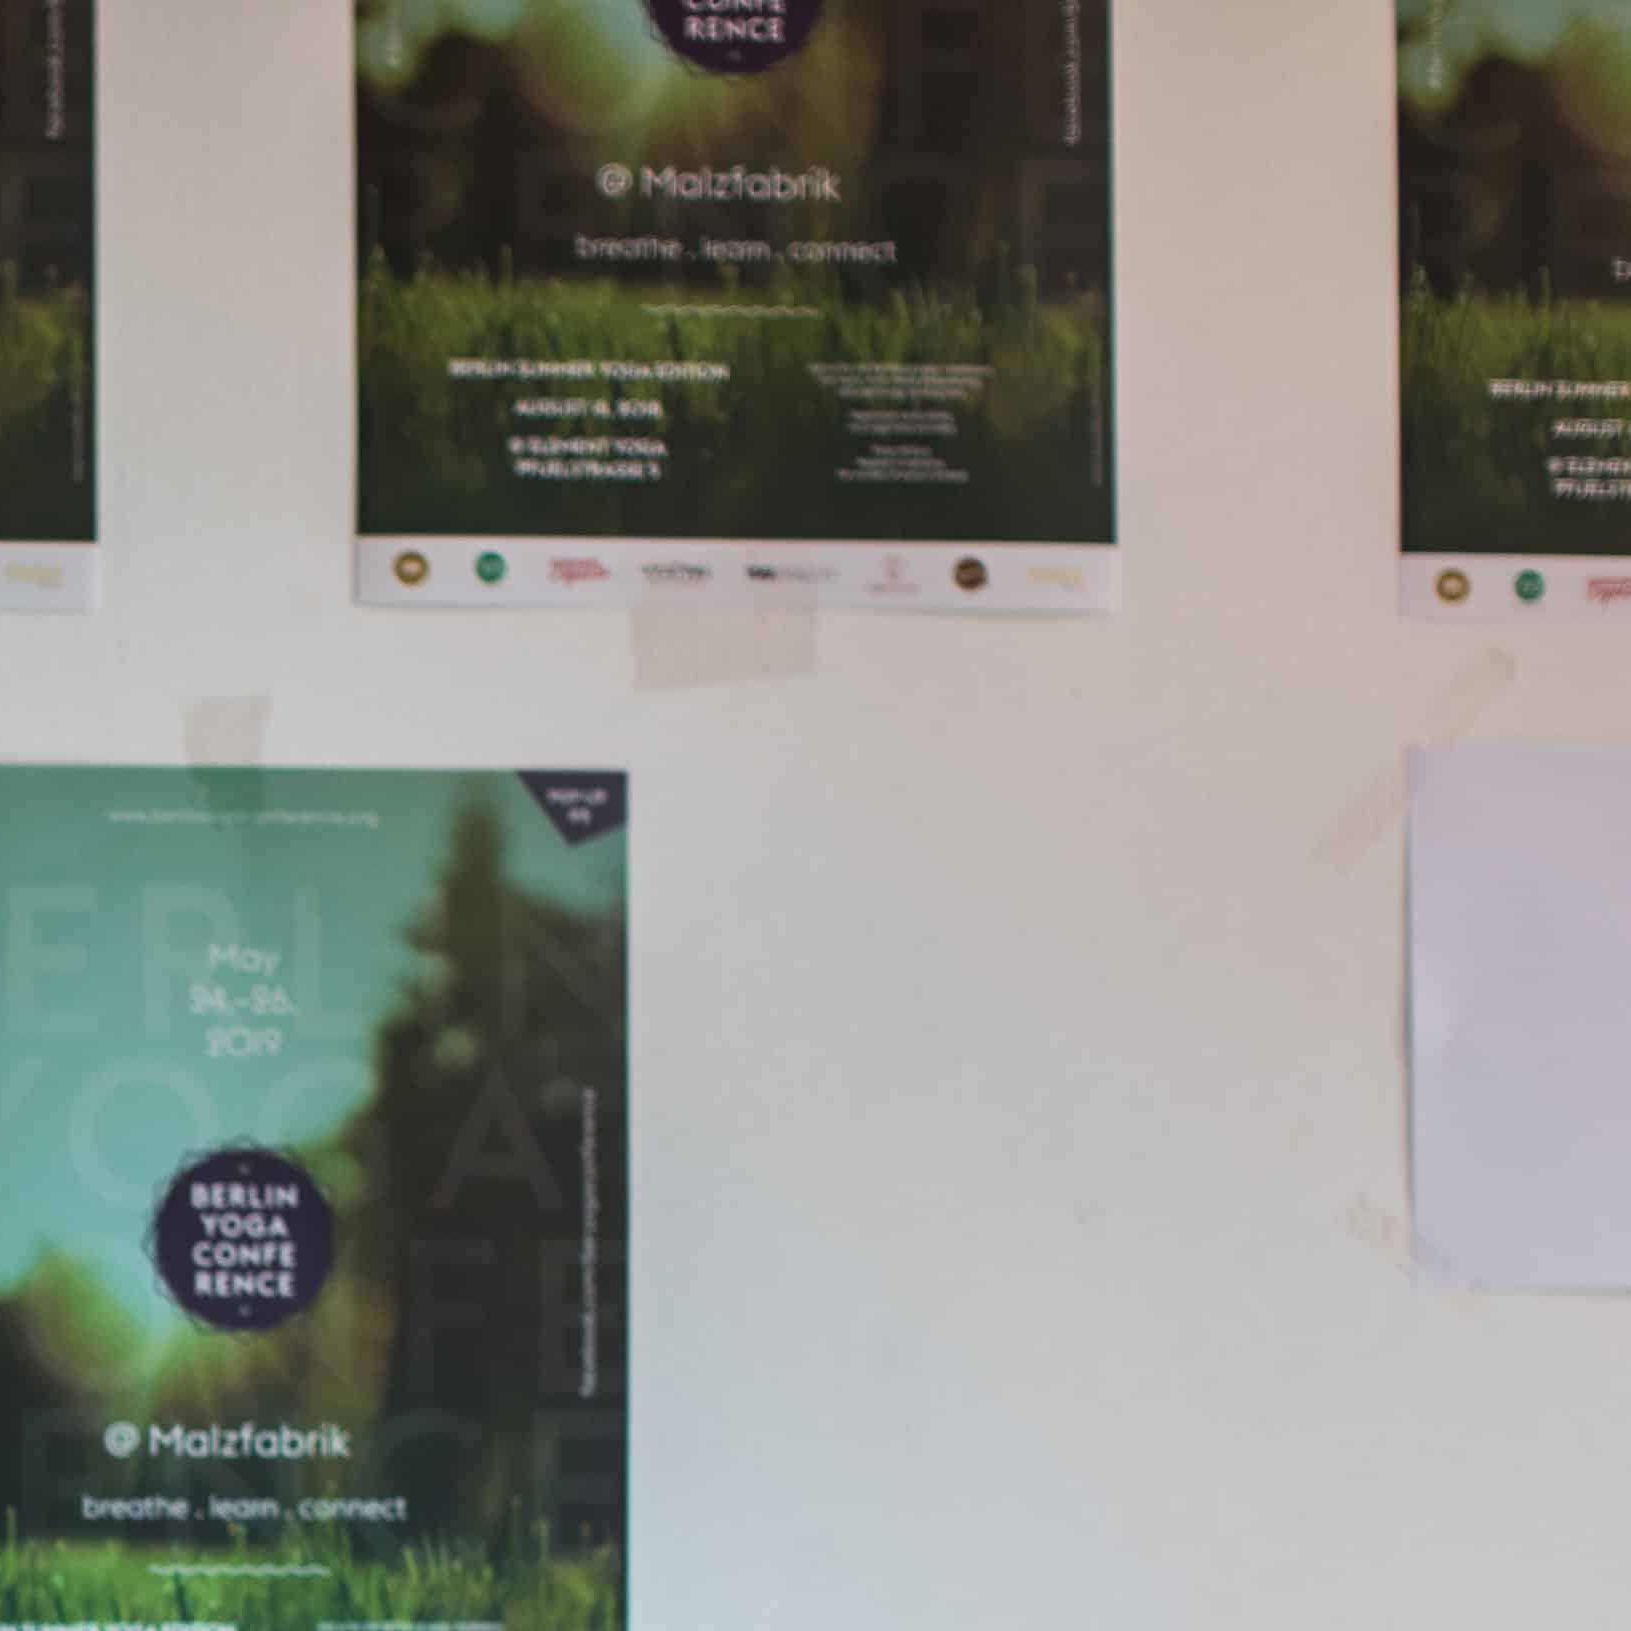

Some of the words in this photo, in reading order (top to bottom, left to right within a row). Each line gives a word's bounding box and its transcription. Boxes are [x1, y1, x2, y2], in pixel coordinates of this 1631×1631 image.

[682, 13, 785, 44] RENCE
[596, 162, 633, 199] @
[640, 162, 842, 203] Malzfabrik
[575, 234, 683, 260] breathe
[699, 234, 772, 260] learn
[786, 237, 897, 263] connect
[208, 943, 280, 977] May
[205, 1026, 281, 1057] 2019
[189, 1181, 299, 1209] BERLIN
[198, 1211, 290, 1239] YOGA
[190, 1240, 297, 1268] CONFE
[192, 1269, 296, 1299] RENCE
[102, 1421, 140, 1459] @
[147, 1421, 352, 1459] Malzfabrik
[81, 1495, 191, 1519] breathe
[207, 1493, 281, 1518] learn
[296, 1495, 409, 1520] connect
